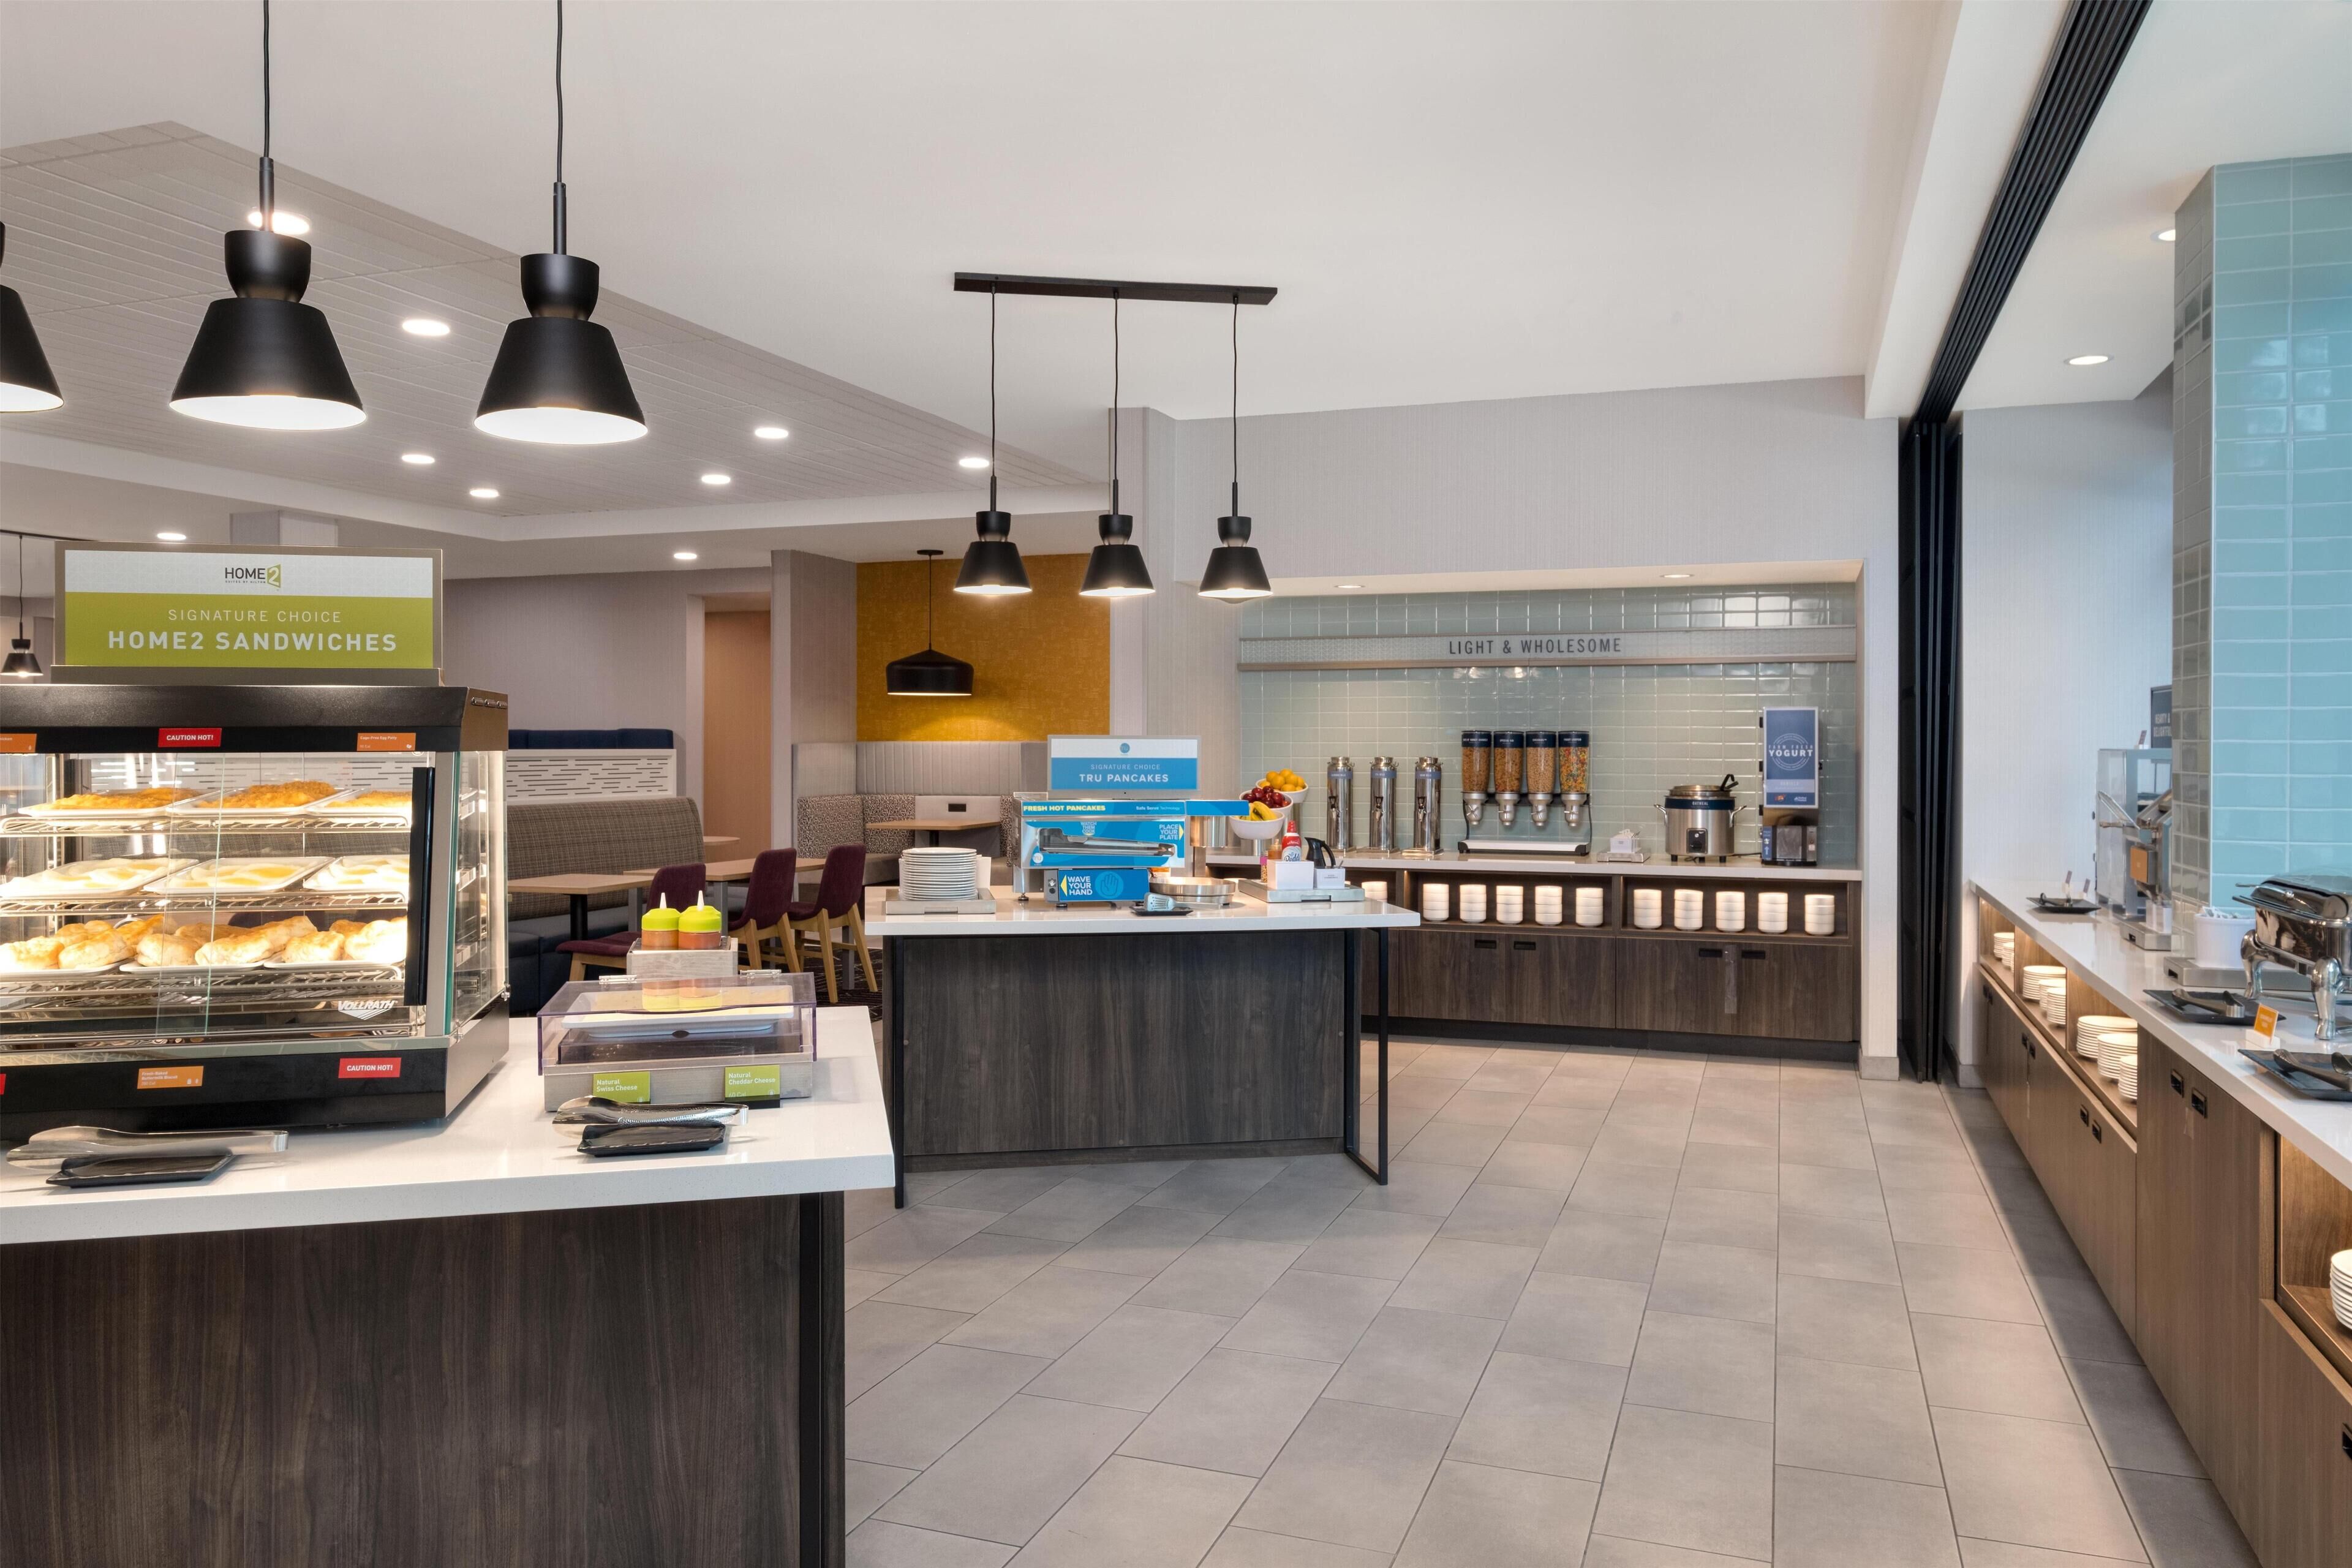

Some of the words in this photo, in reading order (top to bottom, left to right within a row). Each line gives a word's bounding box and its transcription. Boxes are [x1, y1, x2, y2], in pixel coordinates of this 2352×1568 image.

[168, 609, 268, 622] SIGNATURE
[277, 611, 341, 622] CHOICE
[108, 631, 204, 649] HOME2
[215, 632, 396, 651] SANDWICHES
[1449, 640, 1493, 655] LIGHT
[1502, 640, 1512, 654] &
[1520, 638, 1621, 654] WHOLESOME
[1079, 774, 1102, 782] TRU
[1107, 774, 1169, 782] PANCAKES
[337, 1000, 396, 1010] VOLLRATH
